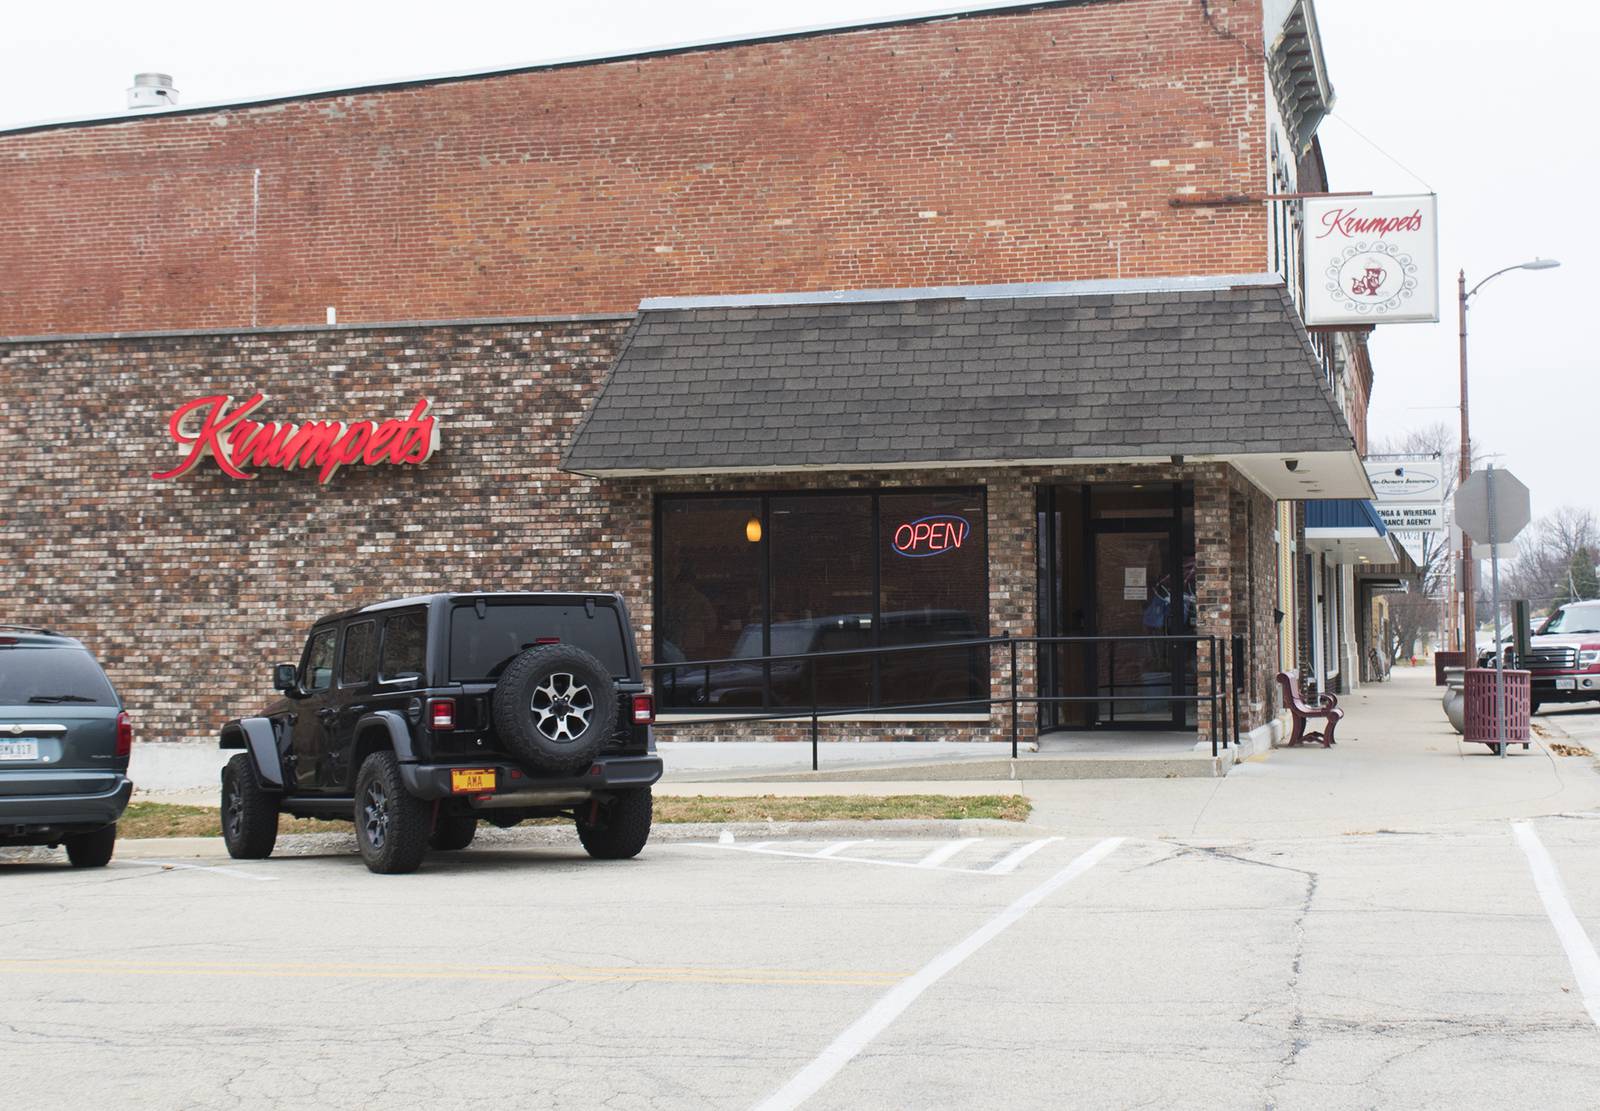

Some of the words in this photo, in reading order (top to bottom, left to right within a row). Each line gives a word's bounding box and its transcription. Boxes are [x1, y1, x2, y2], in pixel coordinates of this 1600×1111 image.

[1315, 208, 1422, 239] Krumpets
[152, 393, 437, 485] Krumpets
[895, 523, 963, 550] OPEN
[1406, 518, 1431, 526] AGENCY
